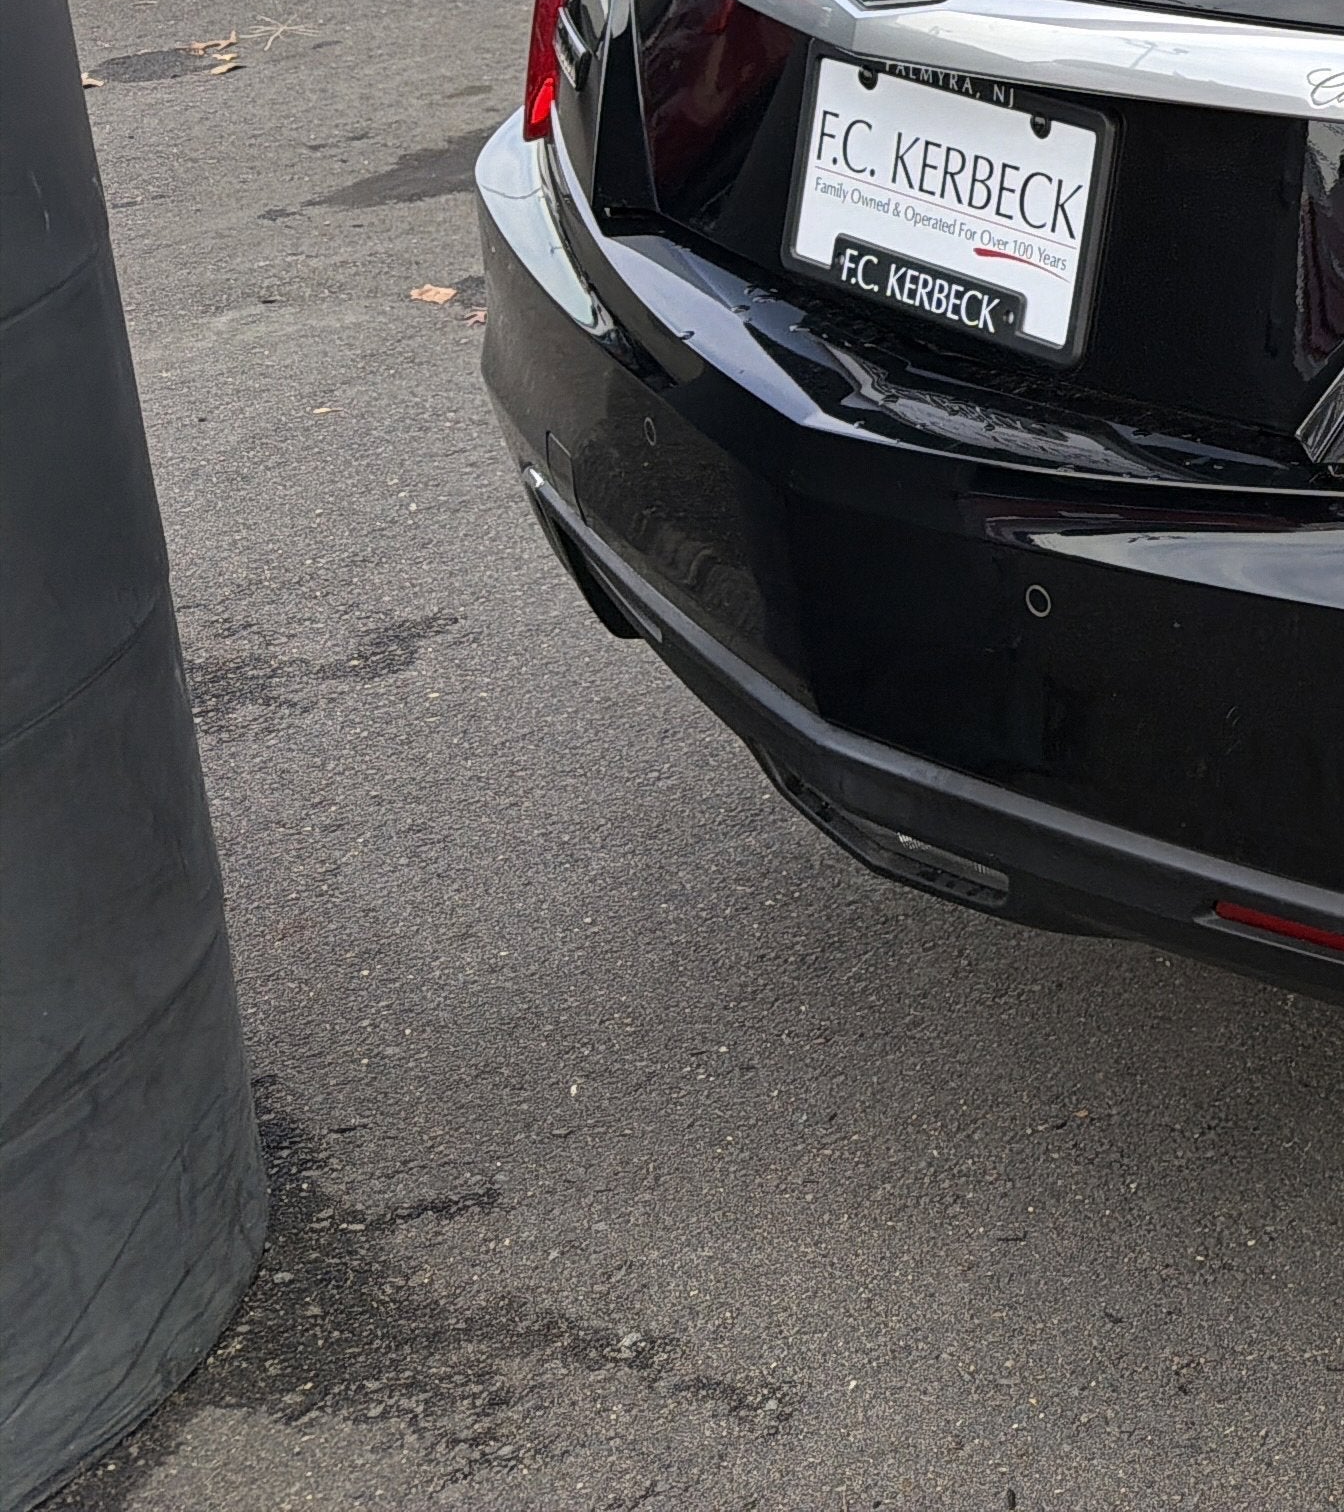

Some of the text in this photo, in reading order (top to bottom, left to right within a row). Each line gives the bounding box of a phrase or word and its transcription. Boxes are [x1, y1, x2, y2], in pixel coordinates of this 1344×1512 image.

[993, 83, 1014, 108] NJ
[815, 109, 1084, 240] F.C. KERBECK
[815, 177, 1067, 271] Family Owned & Operated For Over 100 Years
[841, 248, 1000, 333] F.C. KERBECK
